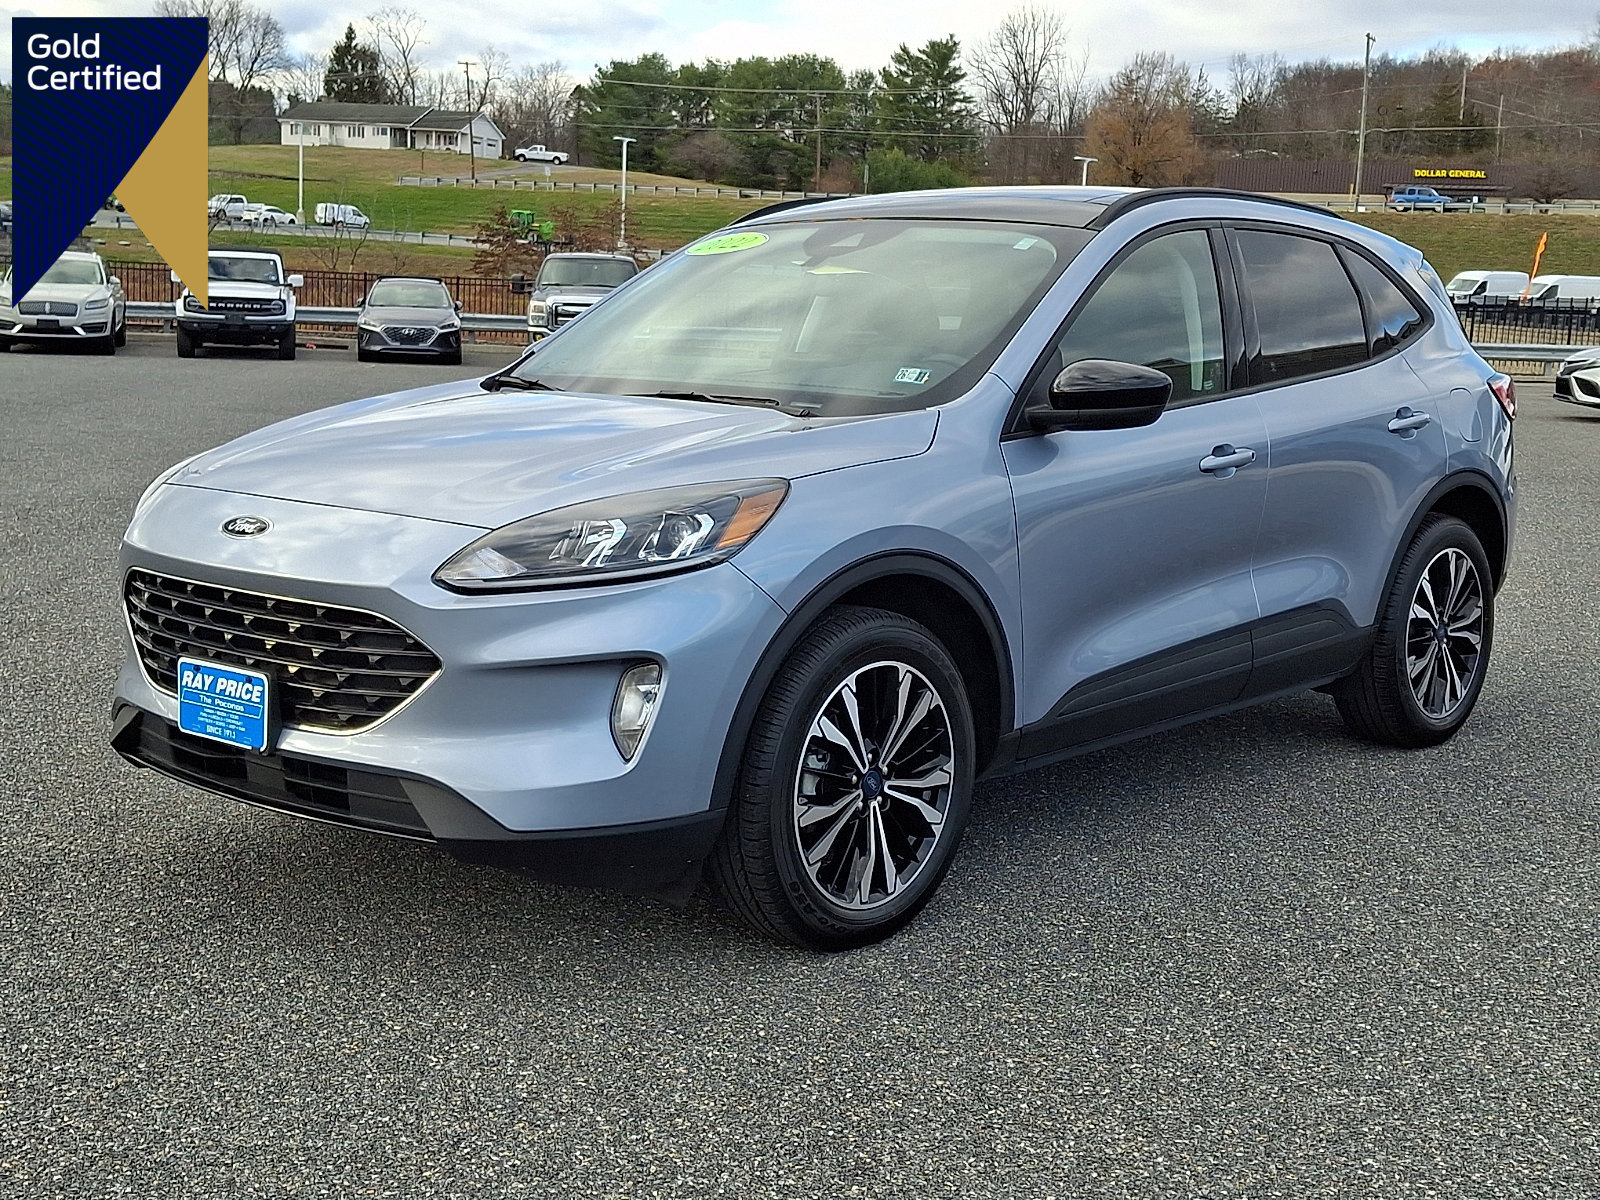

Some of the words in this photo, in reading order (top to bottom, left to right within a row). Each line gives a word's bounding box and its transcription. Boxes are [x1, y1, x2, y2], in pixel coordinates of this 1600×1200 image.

[1414, 169, 1447, 177] DOLLAR
[1448, 170, 1486, 178] GENERAL
[181, 670, 215, 692] RAY
[215, 677, 264, 703] PRICE
[199, 694, 212, 705] The
